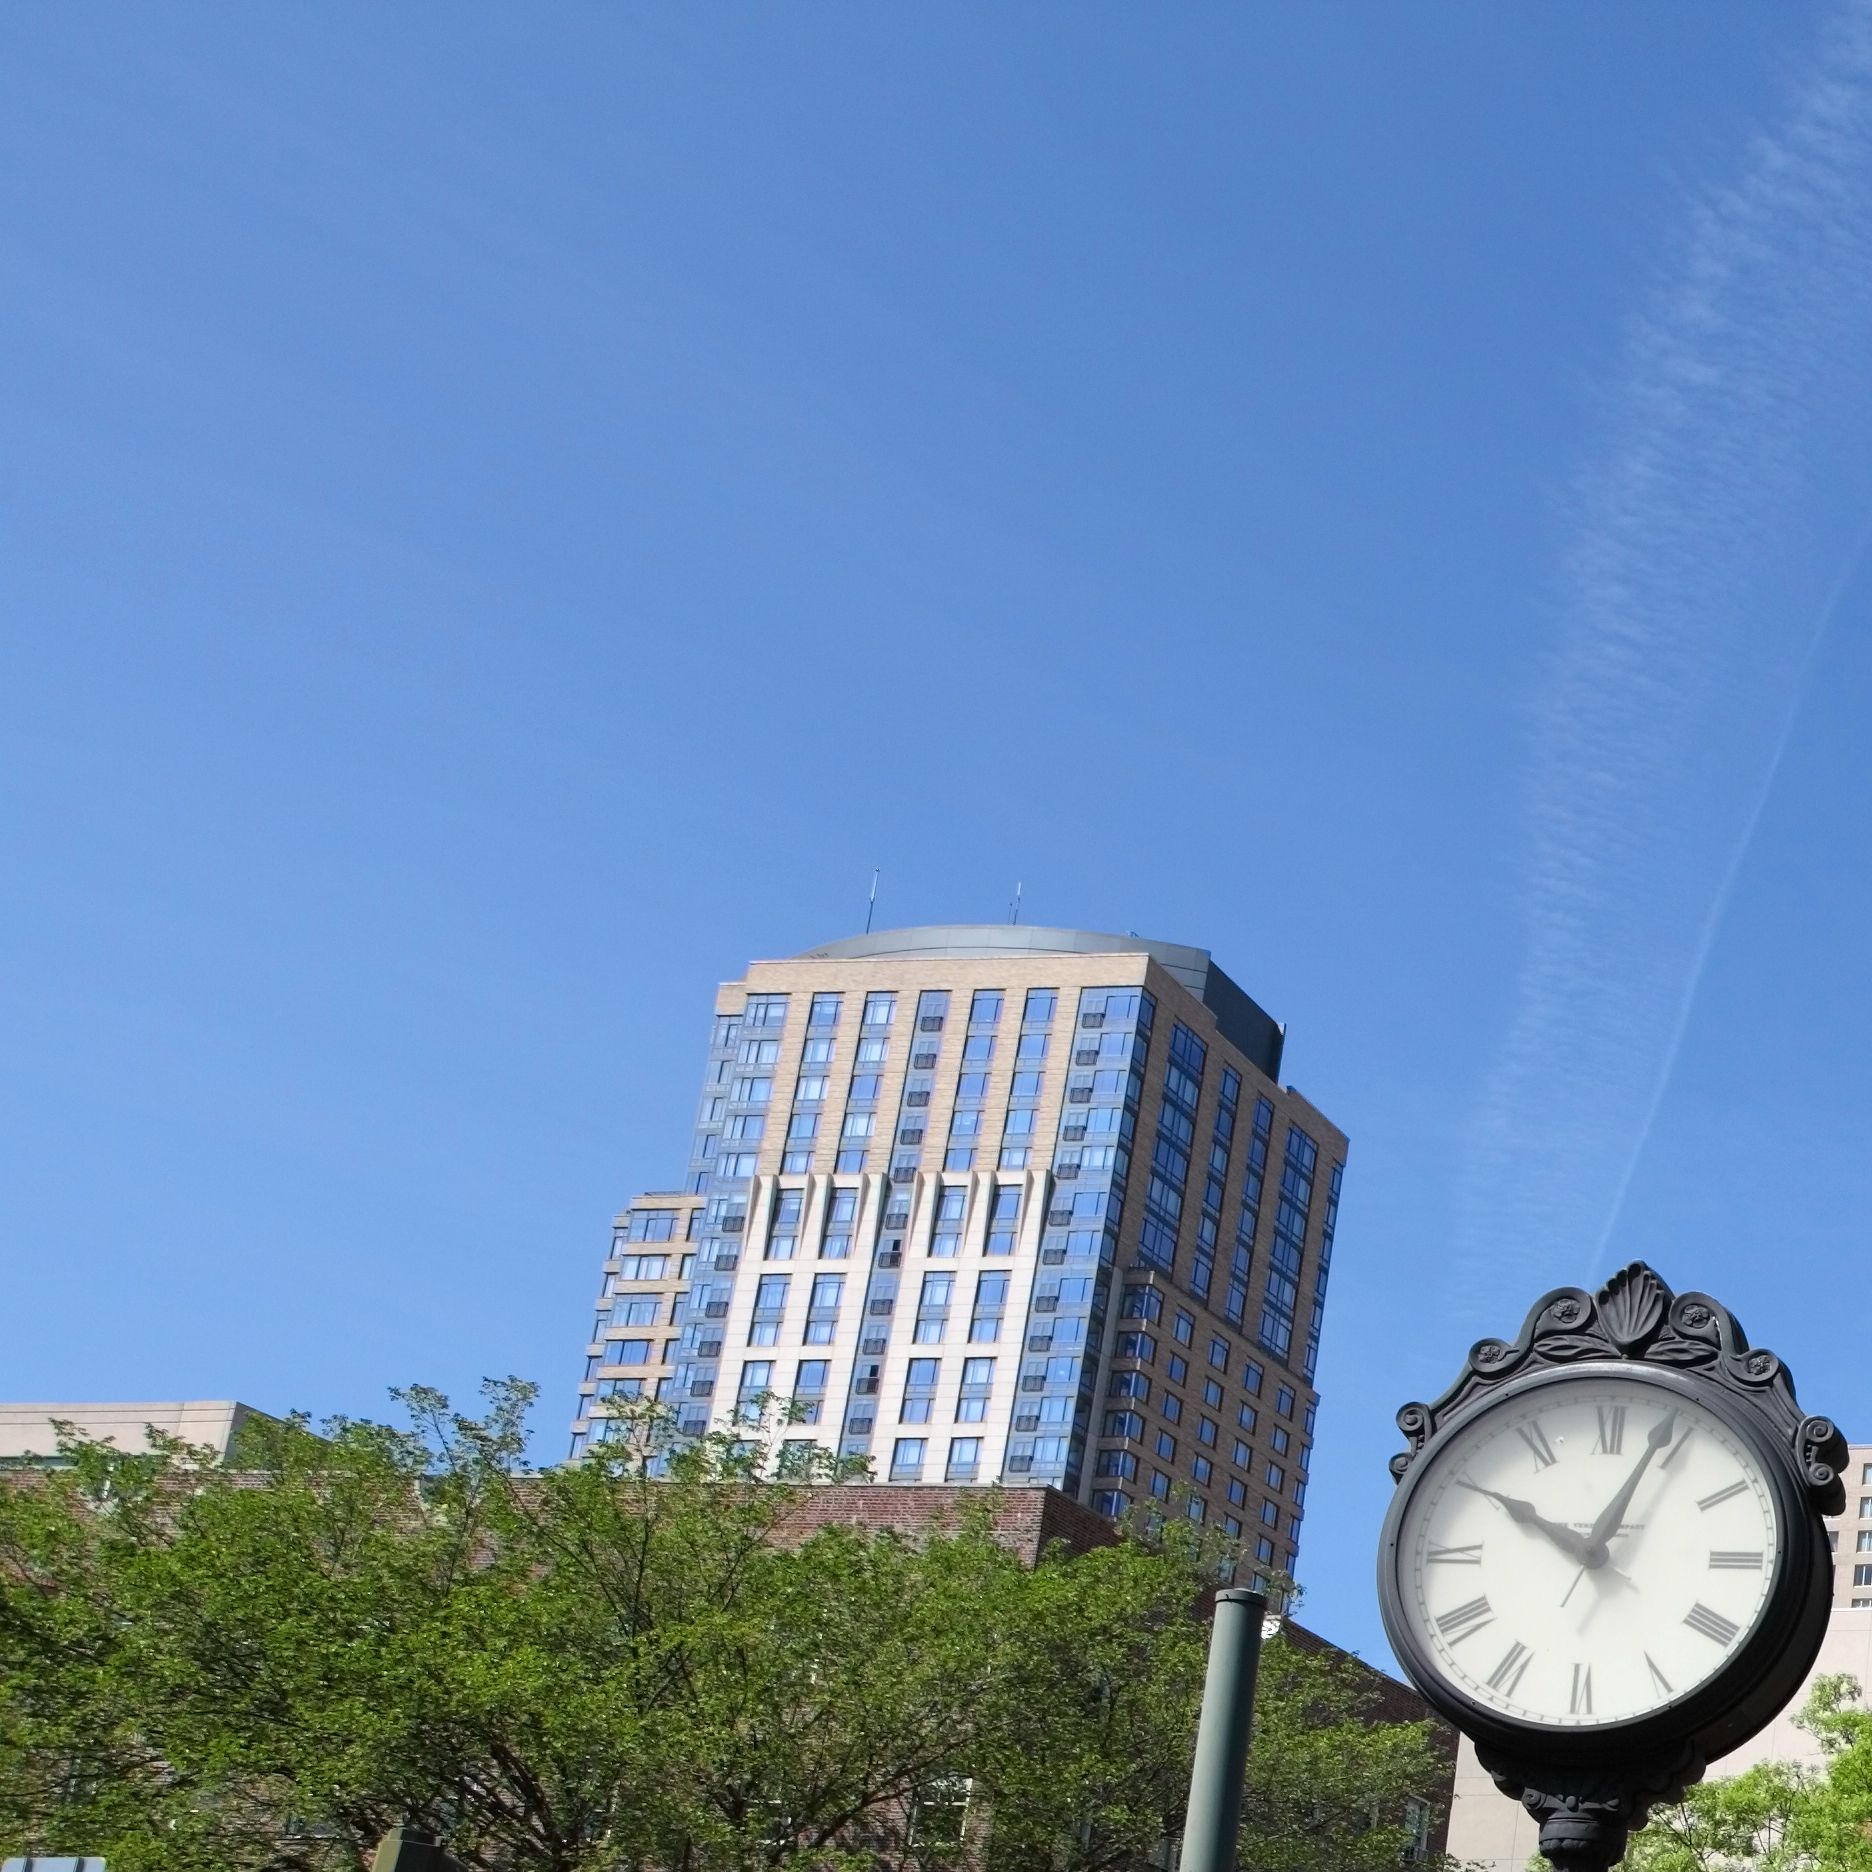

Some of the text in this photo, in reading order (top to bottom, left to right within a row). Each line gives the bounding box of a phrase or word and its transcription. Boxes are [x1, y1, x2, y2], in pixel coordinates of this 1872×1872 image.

[1516, 1420, 1559, 1474] XI
[1591, 1406, 1626, 1455] XII
[1658, 1426, 1694, 1468] I
[1696, 1478, 1749, 1512] II
[1426, 1540, 1484, 1568] IX
[1709, 1550, 1763, 1570] III
